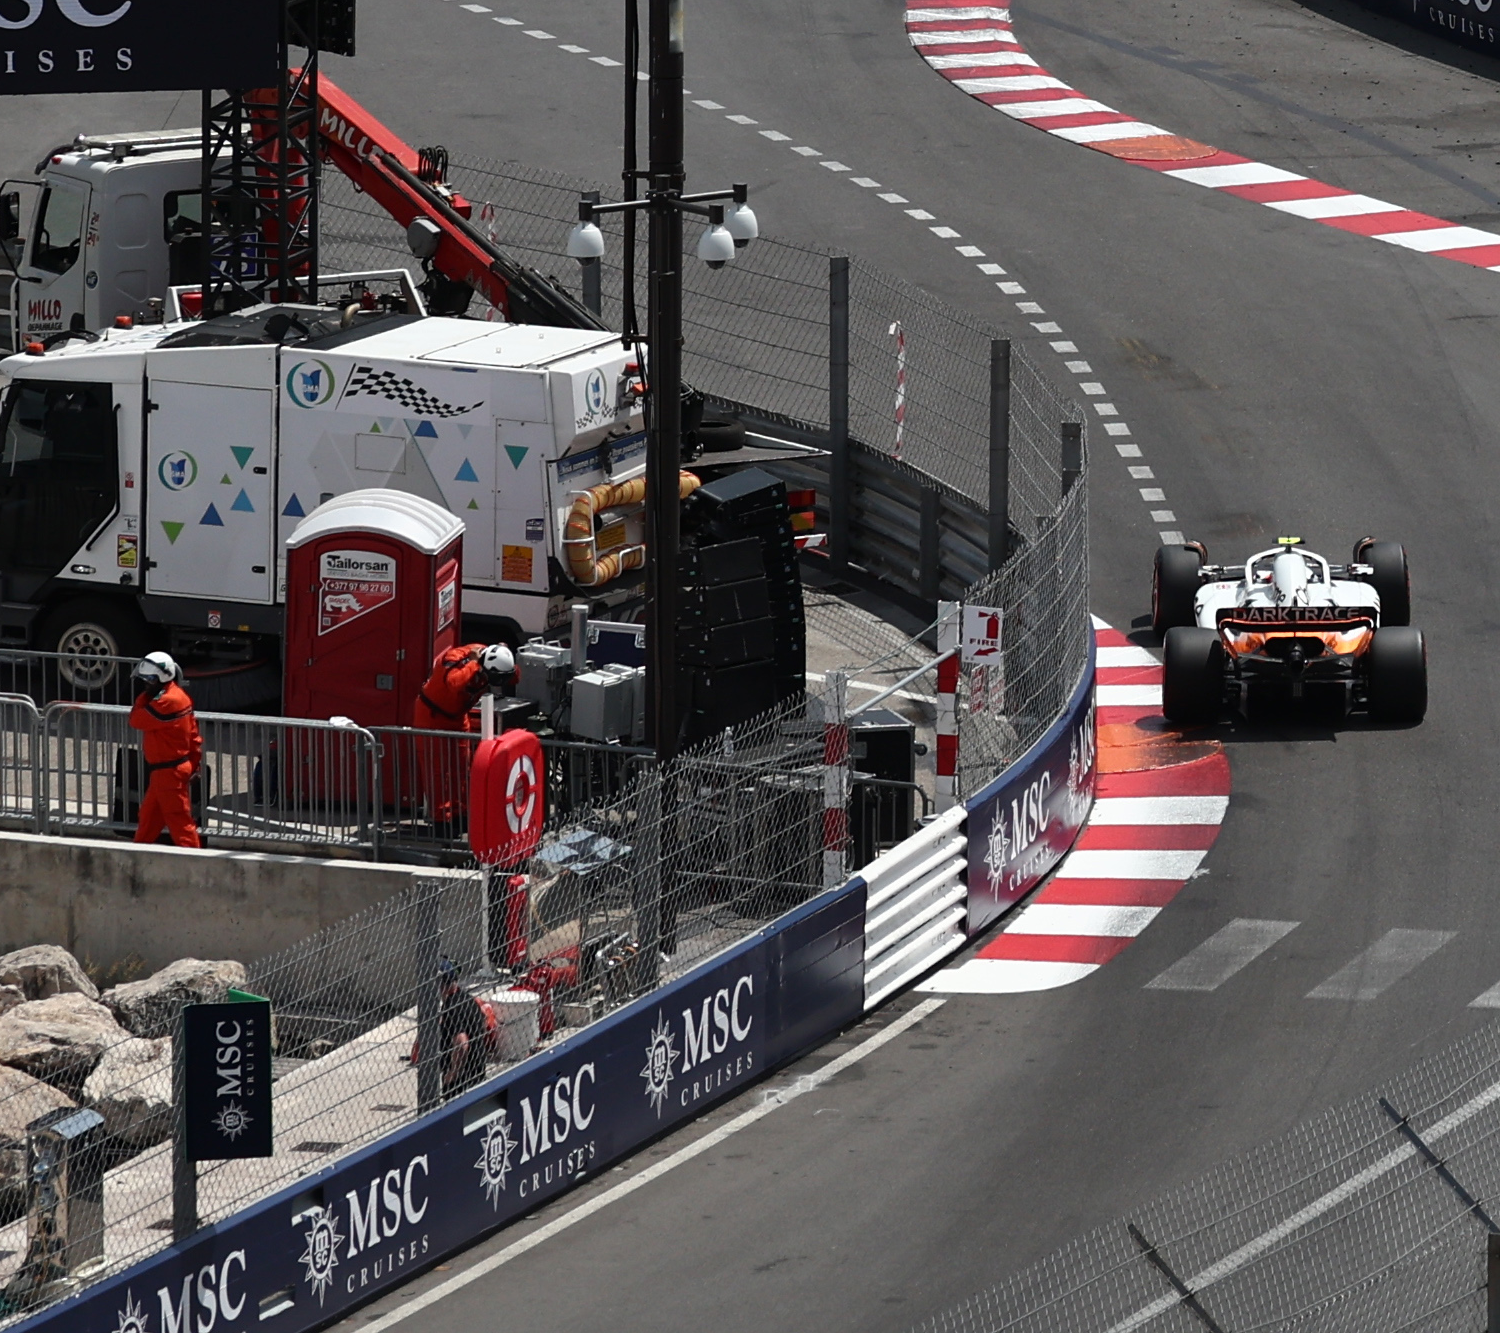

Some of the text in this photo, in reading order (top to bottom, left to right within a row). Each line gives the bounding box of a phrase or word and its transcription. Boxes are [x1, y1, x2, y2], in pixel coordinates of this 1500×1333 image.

[1429, 8, 1495, 43] CRUISES
[27, 299, 53, 320] MILLO
[326, 554, 389, 572] Tailorsan
[349, 583, 358, 592] 97
[370, 584, 379, 593] 27
[381, 585, 390, 594] 60
[969, 637, 999, 646] FIRE
[1234, 606, 1361, 621] DARKTRACE
[1010, 771, 1051, 861] MSC
[1008, 843, 1051, 892] CRUISES
[682, 974, 754, 1074] MSC
[215, 1020, 242, 1098] MSC
[245, 1017, 255, 1097] CRUISES
[680, 1050, 754, 1107] CRUISES
[520, 1064, 596, 1166] MSC
[519, 1140, 597, 1198] CRUISES
[346, 1153, 429, 1260] MSC
[157, 1249, 248, 1333] MSC
[346, 1235, 429, 1294] CRUISES
